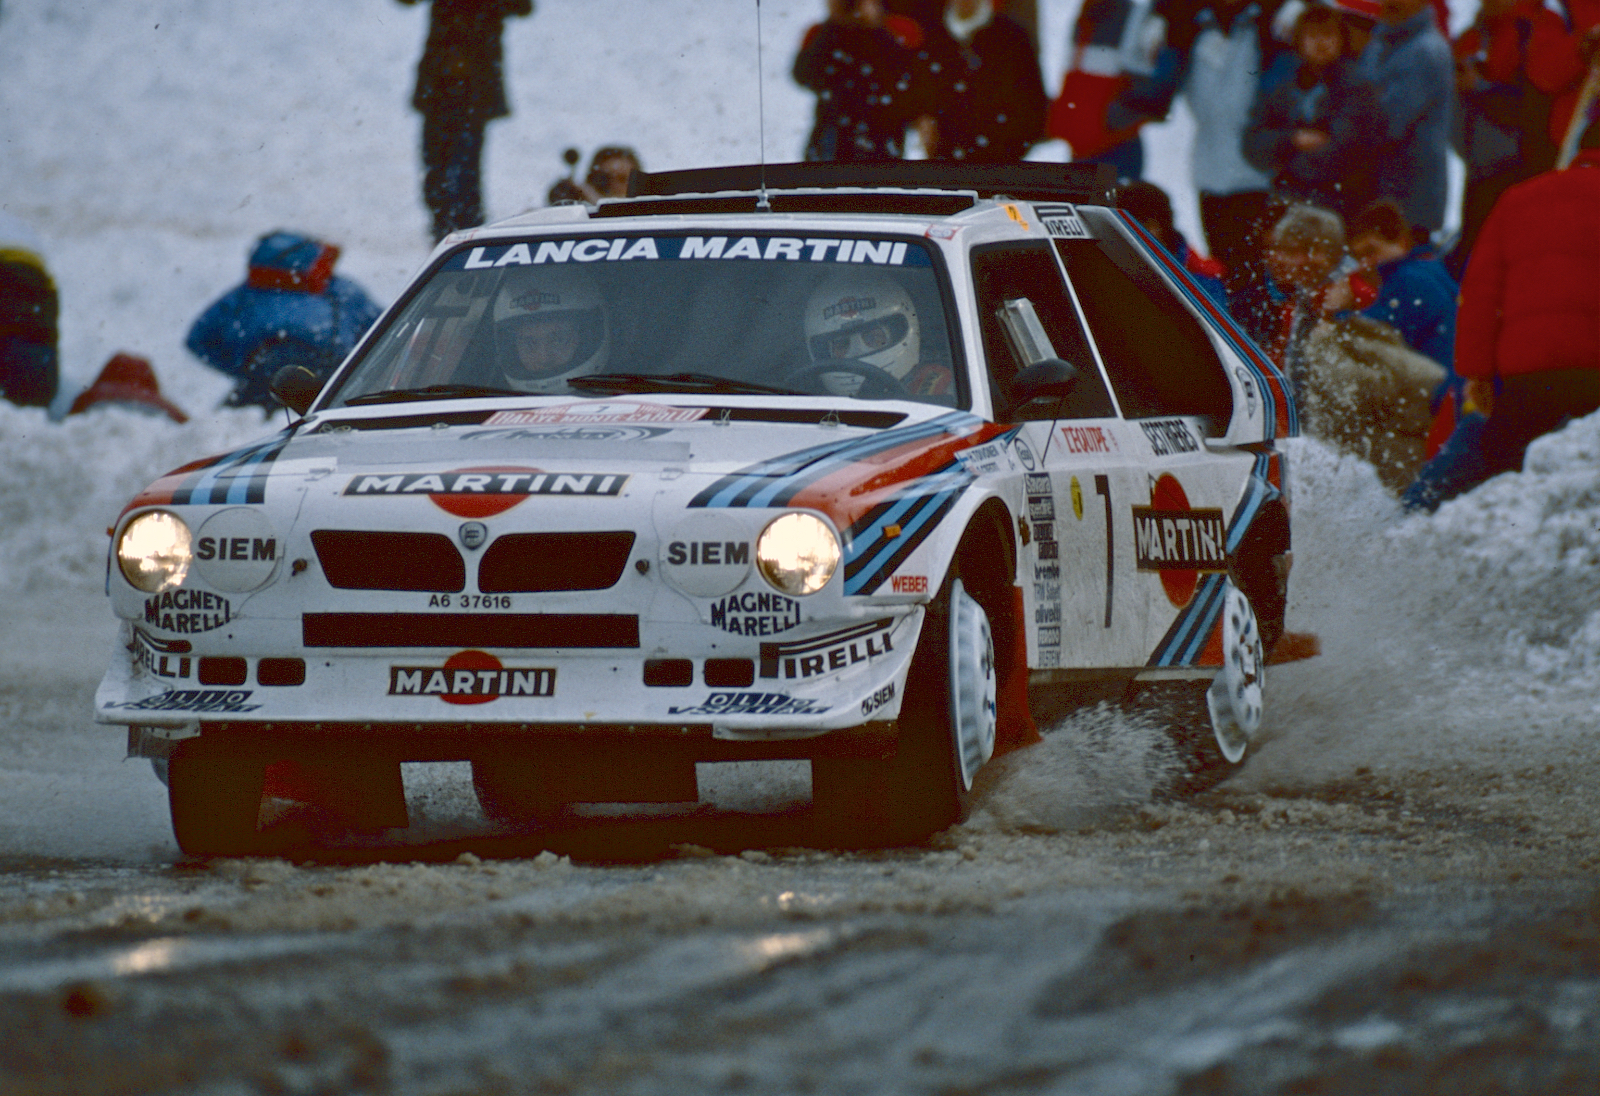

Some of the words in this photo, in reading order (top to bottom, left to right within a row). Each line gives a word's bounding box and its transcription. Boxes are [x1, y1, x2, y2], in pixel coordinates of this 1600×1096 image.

[463, 237, 660, 270] LANCIA
[679, 236, 908, 265] MARTINI
[355, 473, 617, 494] MARTINI
[196, 537, 277, 562] SIEM
[1094, 474, 1114, 629] 7
[1135, 516, 1226, 562] MARTINI
[667, 541, 750, 566] SIEM
[891, 575, 929, 594] WEBER
[144, 589, 231, 622] MAGNETI
[428, 594, 451, 608] A6
[460, 594, 512, 609] 37616
[710, 592, 801, 623] MAGNETI
[144, 611, 231, 634] MARELLI
[710, 614, 801, 637] MARELLI
[759, 616, 895, 680] PIRELLI
[394, 669, 550, 695] MARTINI
[701, 692, 819, 707] OLIO
[872, 682, 896, 710] SIEM
